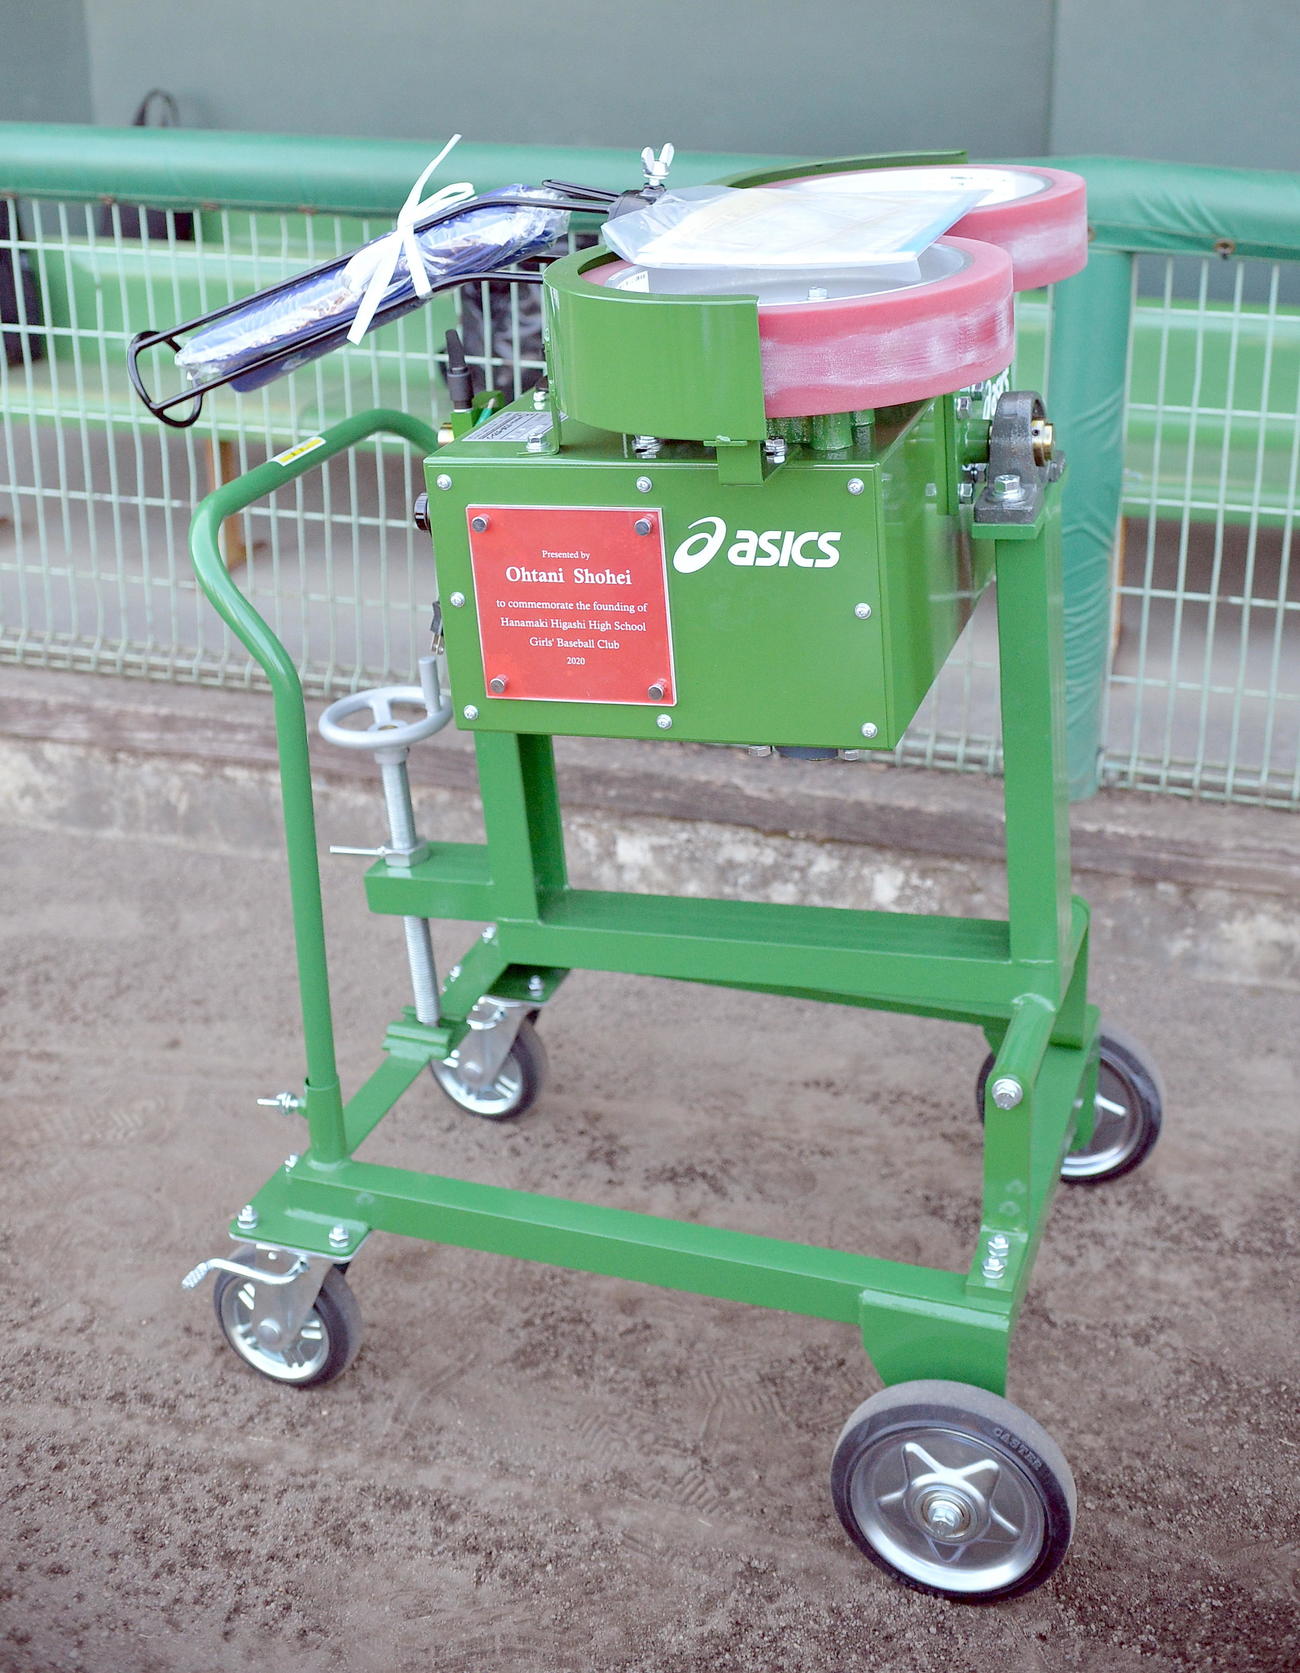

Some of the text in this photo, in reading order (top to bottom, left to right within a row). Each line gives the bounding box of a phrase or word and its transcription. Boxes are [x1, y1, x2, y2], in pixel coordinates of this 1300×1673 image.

[541, 549, 591, 561] Presented by
[727, 529, 842, 568] asics
[505, 566, 633, 585] Ohtani Shohei
[495, 599, 649, 614] to commemorate the founding of
[500, 616, 647, 632] Hanamaki Higashi High School
[529, 636, 620, 650] Girls' Baseball Club
[566, 656, 586, 666] 2020
